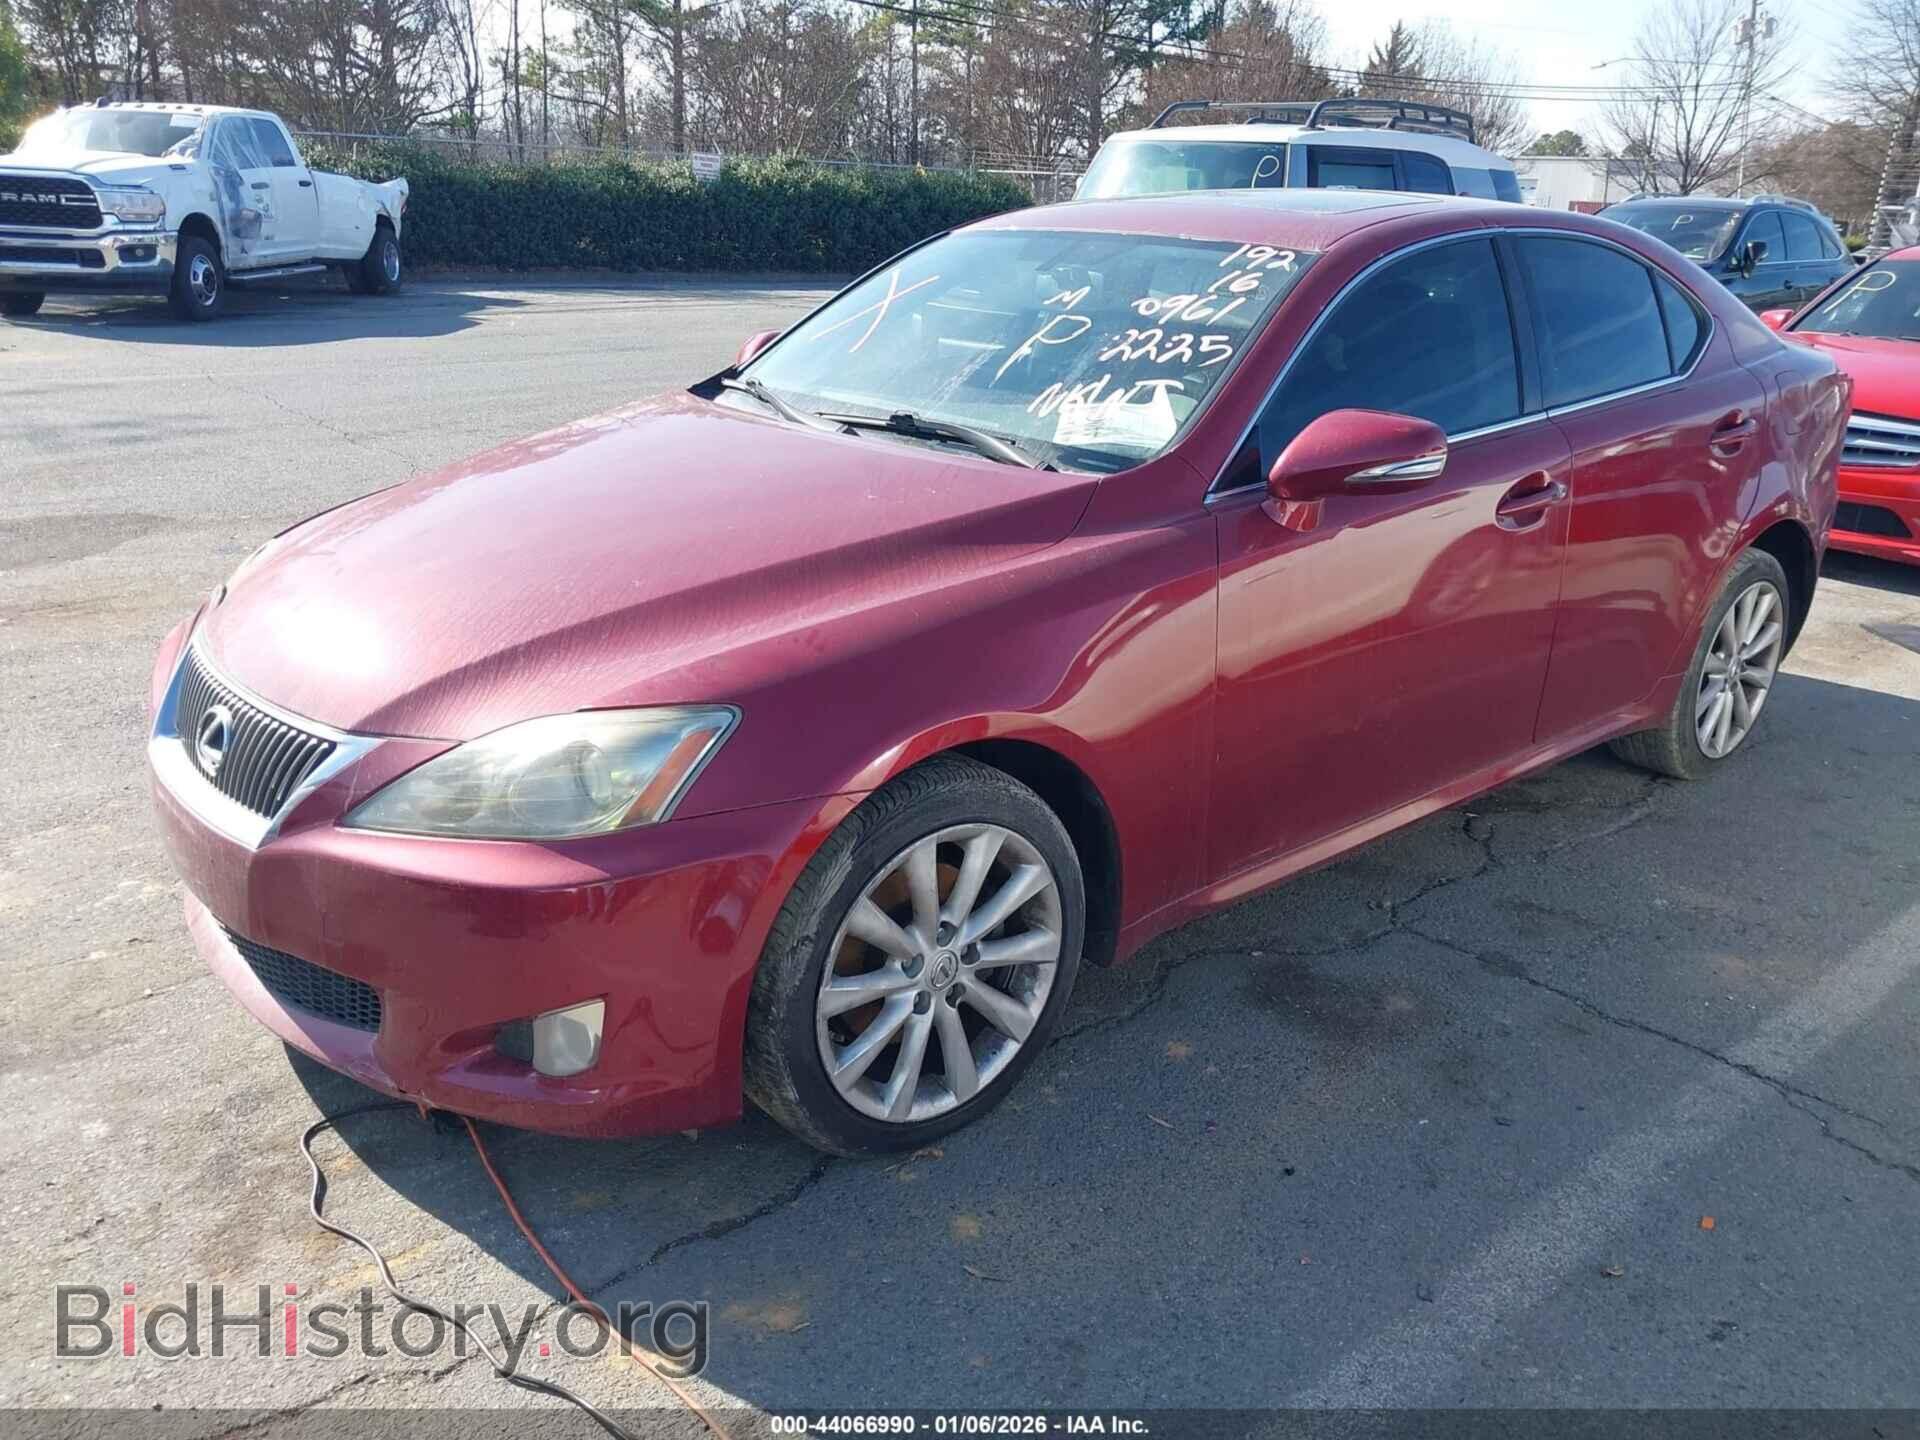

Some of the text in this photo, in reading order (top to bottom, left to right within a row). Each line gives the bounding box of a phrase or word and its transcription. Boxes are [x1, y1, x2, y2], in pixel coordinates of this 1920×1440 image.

[0, 191, 57, 204] RAM
[1671, 214, 1694, 231] P
[1219, 243, 1296, 272] 192
[1207, 270, 1263, 293] 16
[1823, 270, 1897, 314] P
[1131, 294, 1246, 326] 0961
[1099, 328, 1233, 367] 2225
